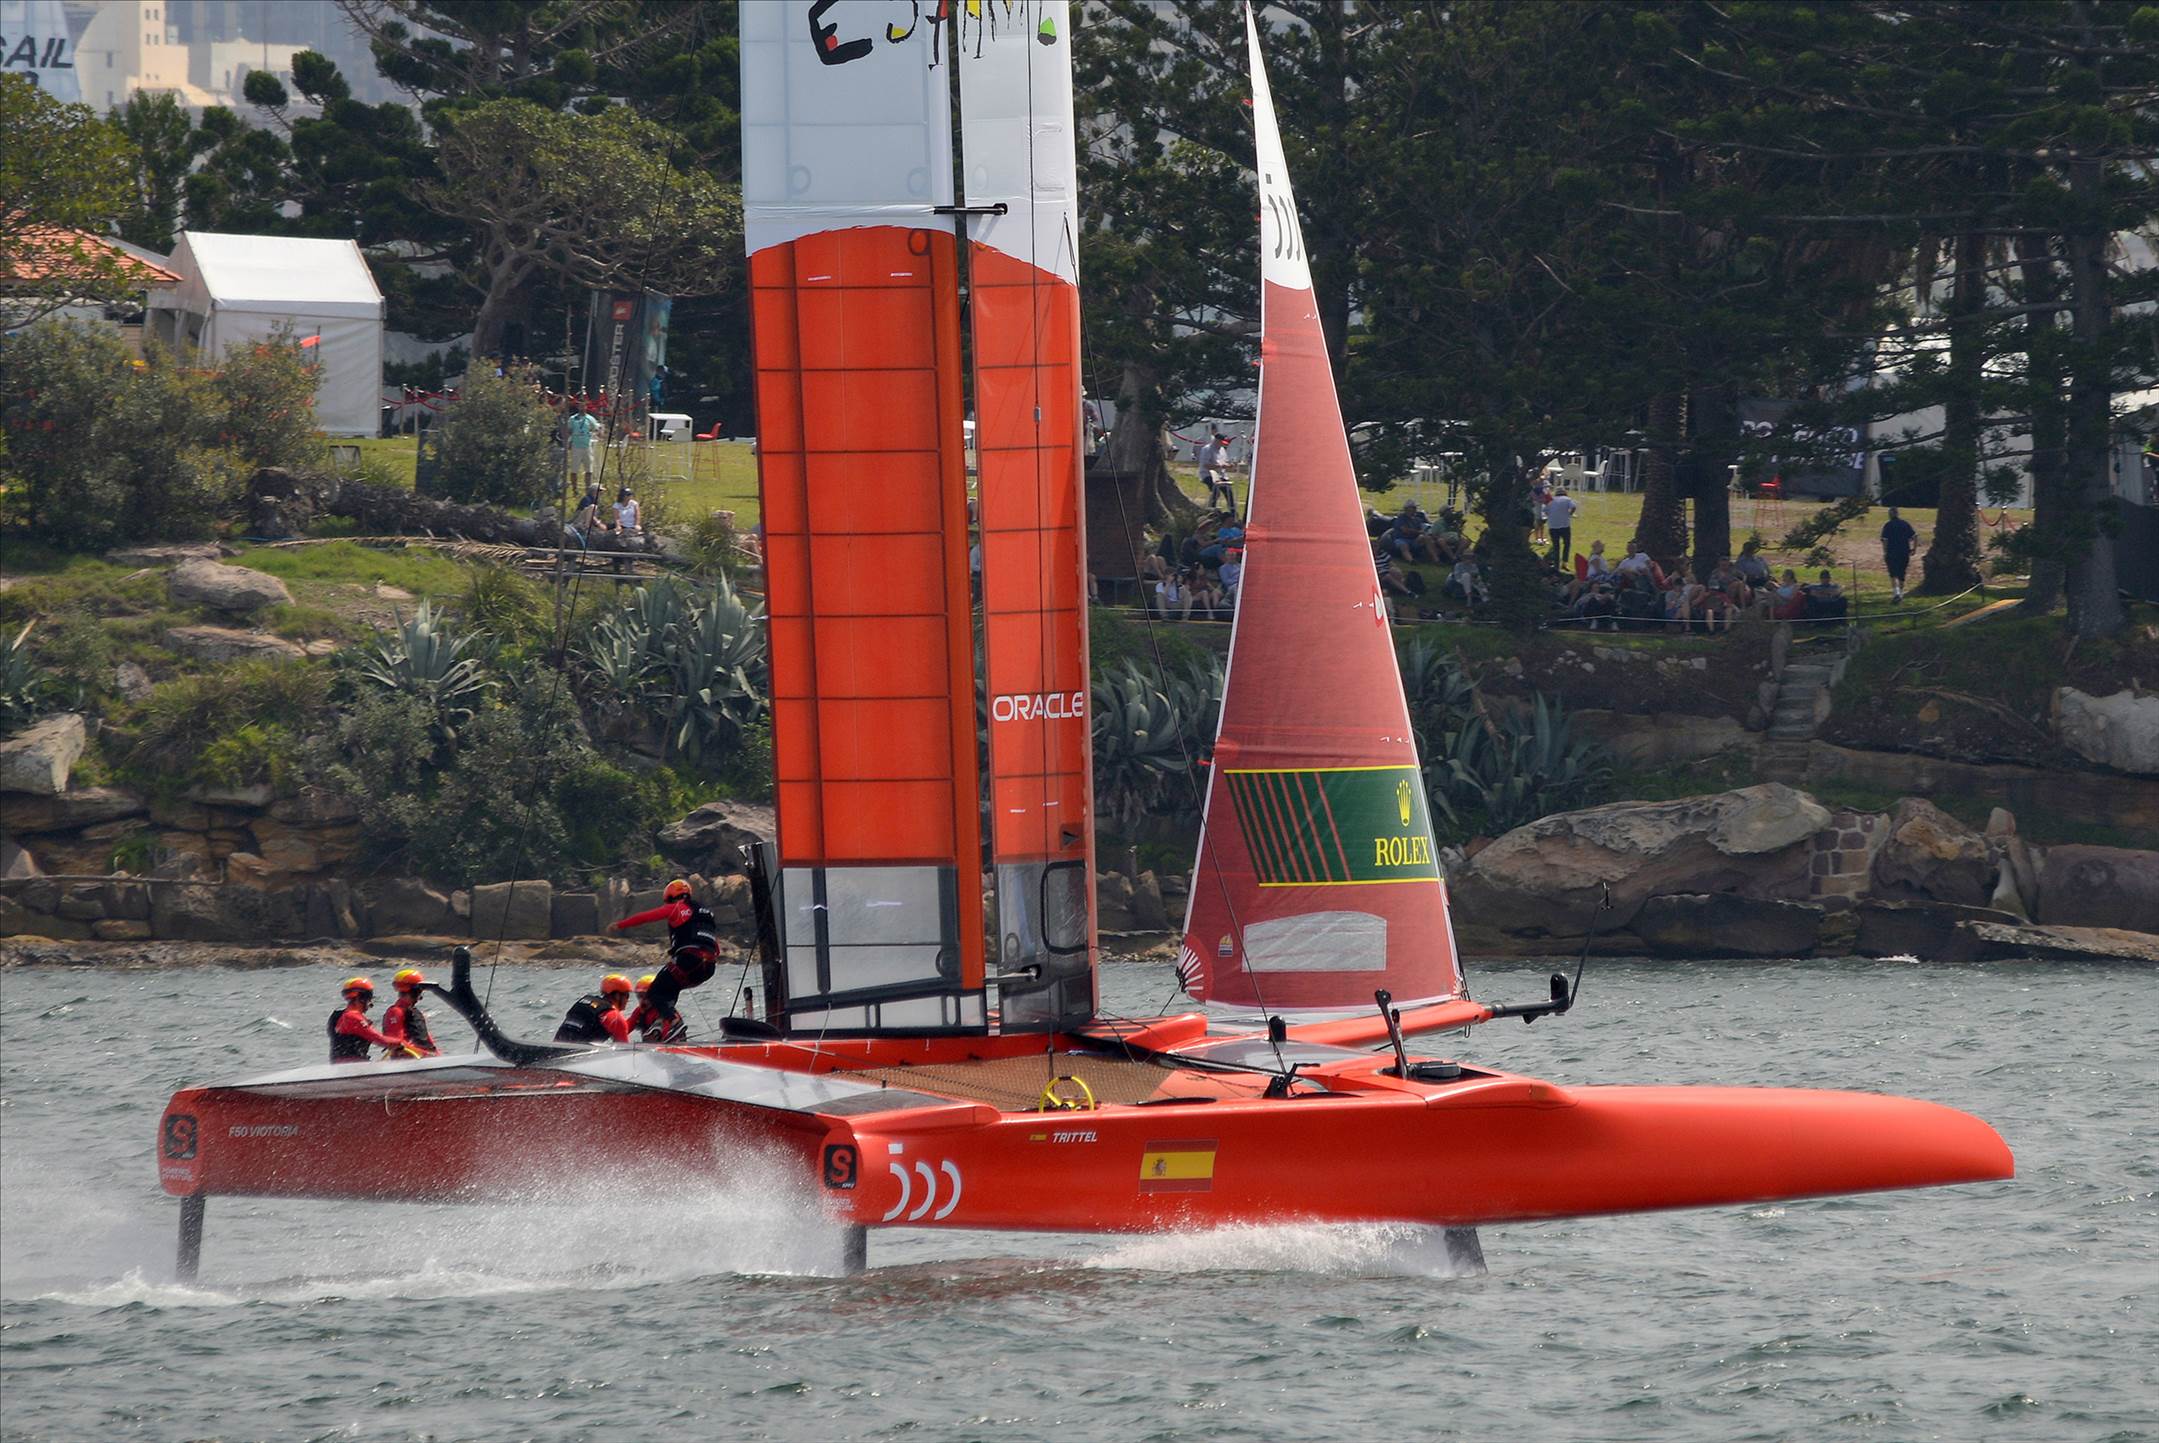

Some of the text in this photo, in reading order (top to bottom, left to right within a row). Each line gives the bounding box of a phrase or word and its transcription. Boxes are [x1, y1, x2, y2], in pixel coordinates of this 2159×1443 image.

[0, 35, 73, 68] AIL
[992, 691, 1084, 722] ORACLE
[1374, 836, 1431, 867] ROLEX
[228, 1124, 299, 1138] F50 VICTORIA
[1052, 1131, 1097, 1143] TRITTEL
